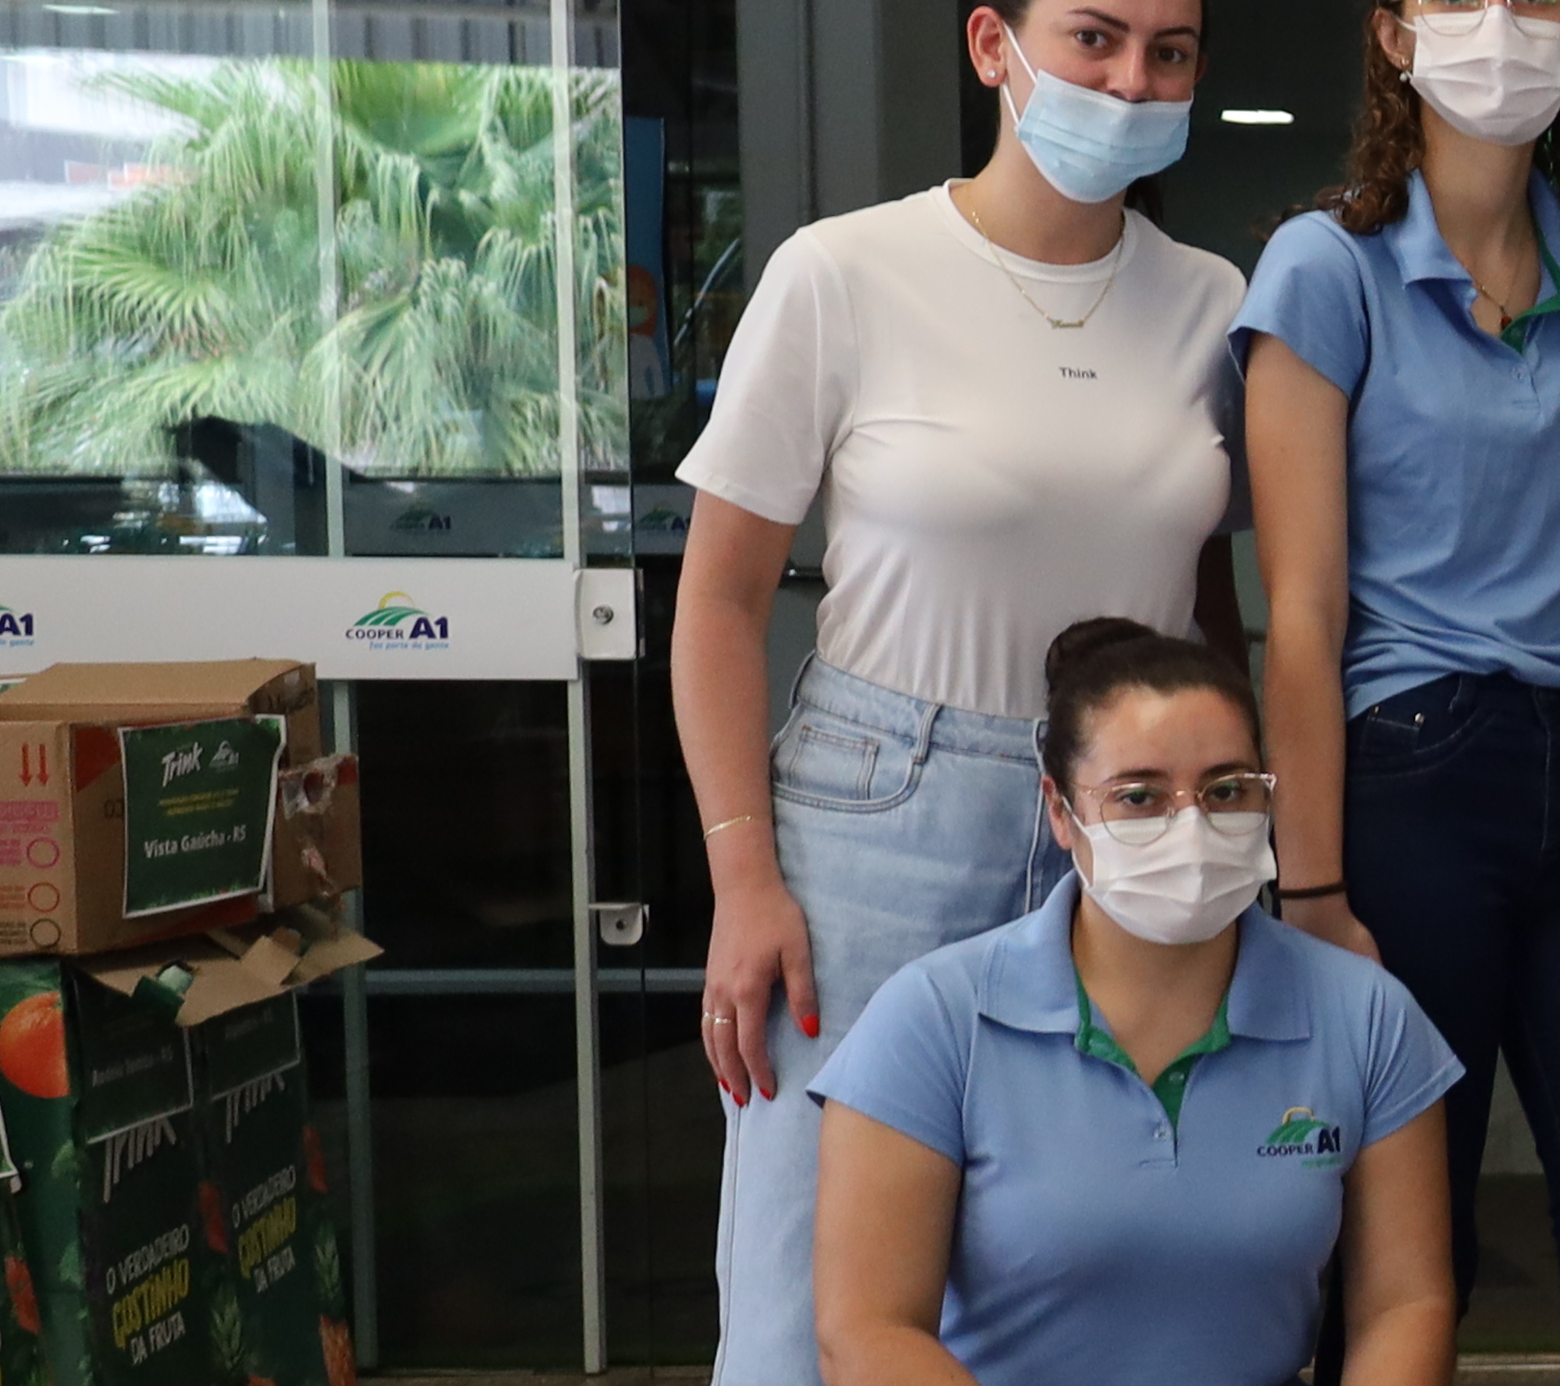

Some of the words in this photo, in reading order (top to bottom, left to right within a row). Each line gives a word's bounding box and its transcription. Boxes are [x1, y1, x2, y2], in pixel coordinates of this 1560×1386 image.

[1059, 367, 1098, 380] Think
[345, 628, 404, 640] COOPER
[409, 616, 449, 640] A1
[162, 742, 203, 788] Trink
[144, 839, 178, 859] Vista
[233, 824, 246, 842] RS
[1317, 1126, 1340, 1154] A1
[118, 1223, 190, 1285] VERDADEIRO
[131, 1334, 148, 1366] DA
[149, 1311, 187, 1353] FRUTA
